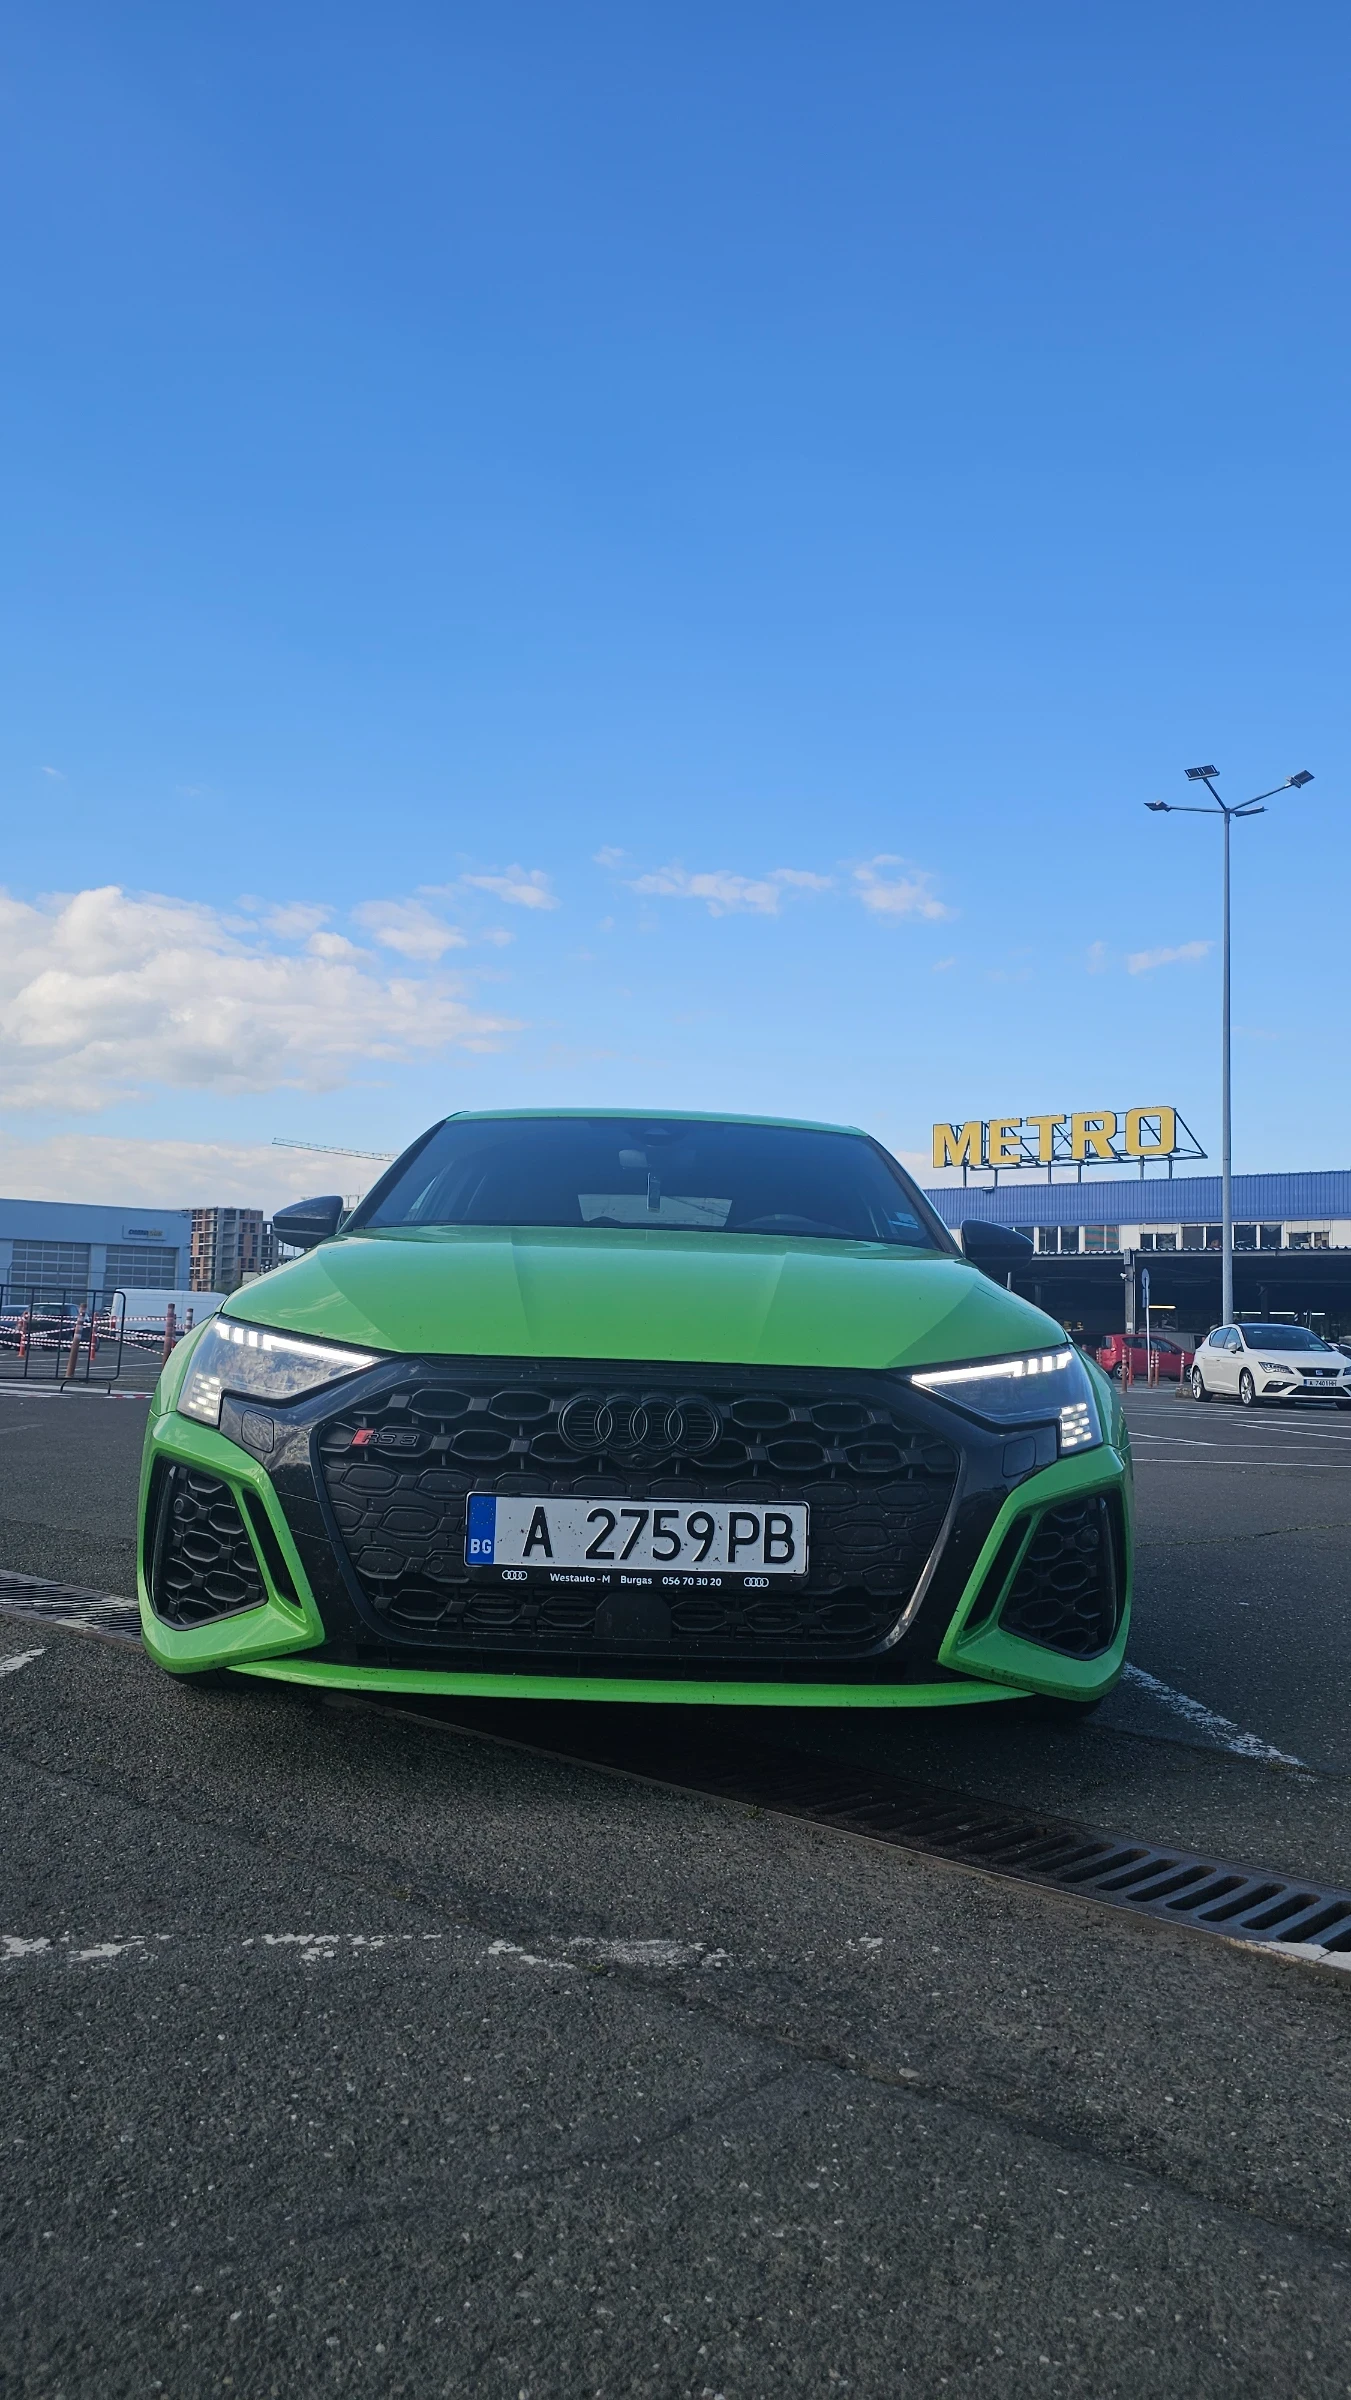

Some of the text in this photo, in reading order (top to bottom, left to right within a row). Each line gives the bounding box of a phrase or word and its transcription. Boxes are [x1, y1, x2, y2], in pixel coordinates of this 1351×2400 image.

[932, 1105, 1177, 1168] METRO
[364, 1432, 417, 1445] RS 3
[522, 1505, 554, 1558] A
[470, 1538, 492, 1554] BG
[620, 1575, 653, 1586] Burgas
[662, 1576, 681, 1586] 056
[682, 1576, 694, 1586] 70
[696, 1577, 708, 1586] 30
[709, 1577, 722, 1587] 20
